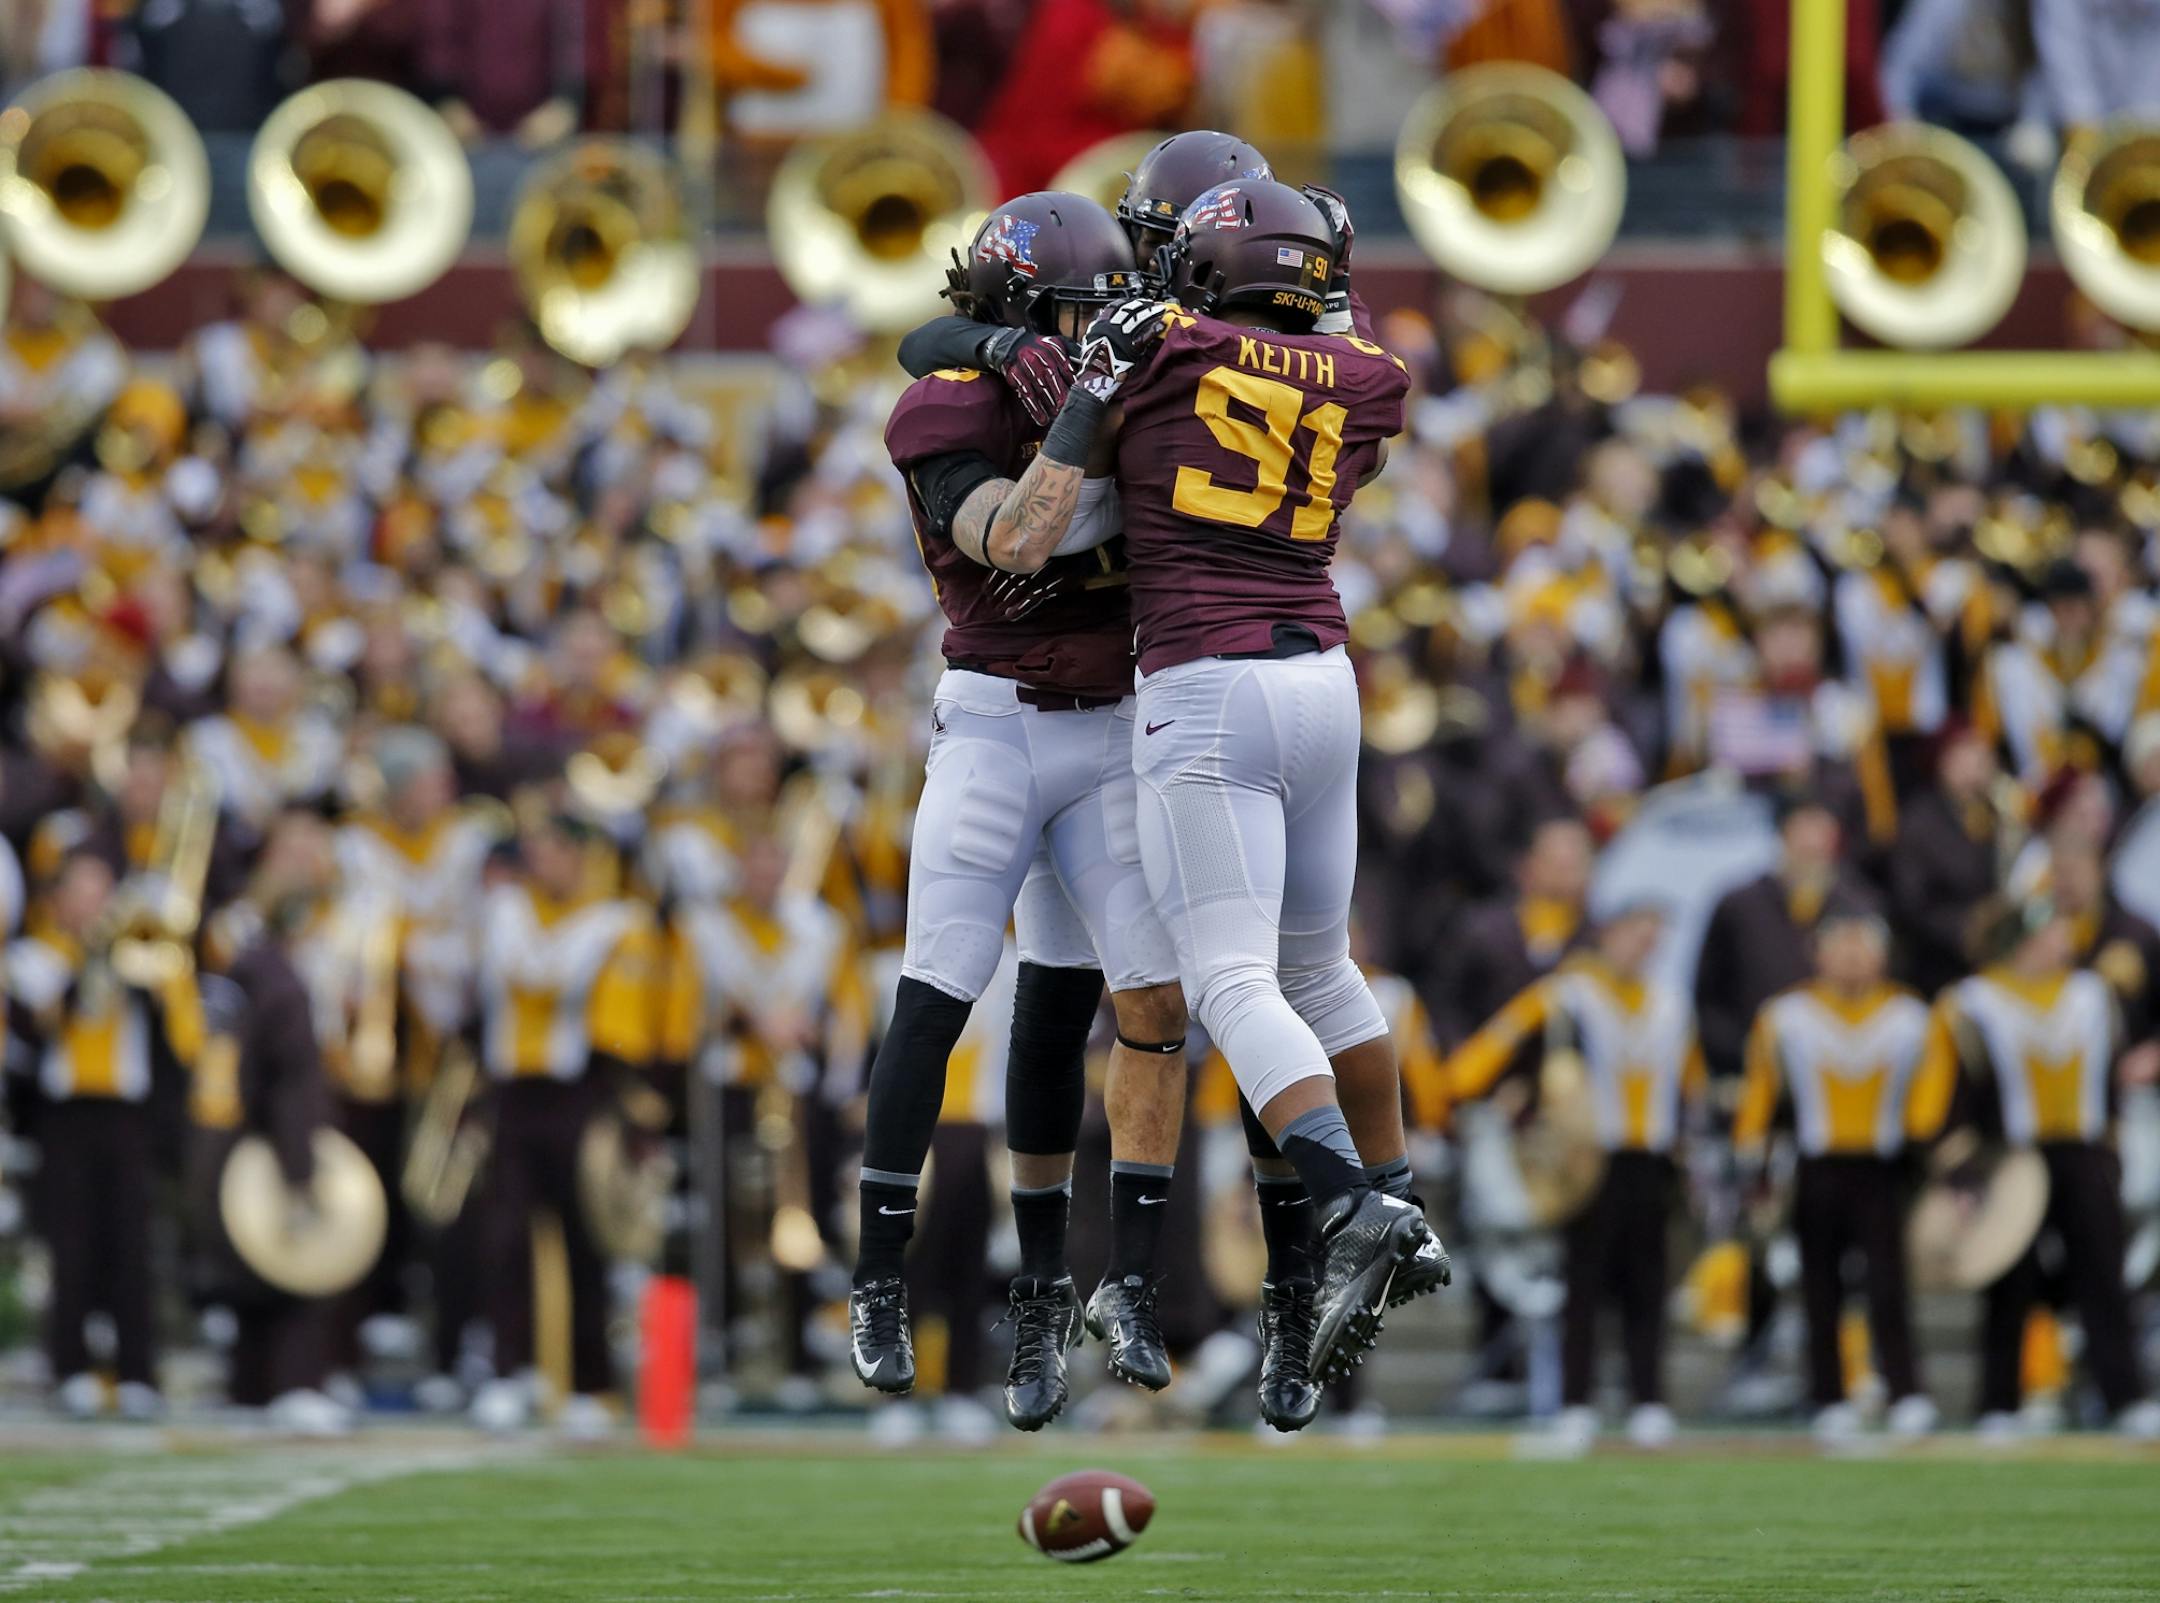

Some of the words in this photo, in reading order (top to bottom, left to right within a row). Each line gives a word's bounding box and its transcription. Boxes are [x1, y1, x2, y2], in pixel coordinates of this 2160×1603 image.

[1313, 256, 1328, 281] 91
[1237, 335, 1335, 388] KEITH
[1172, 366, 1349, 541] 91
